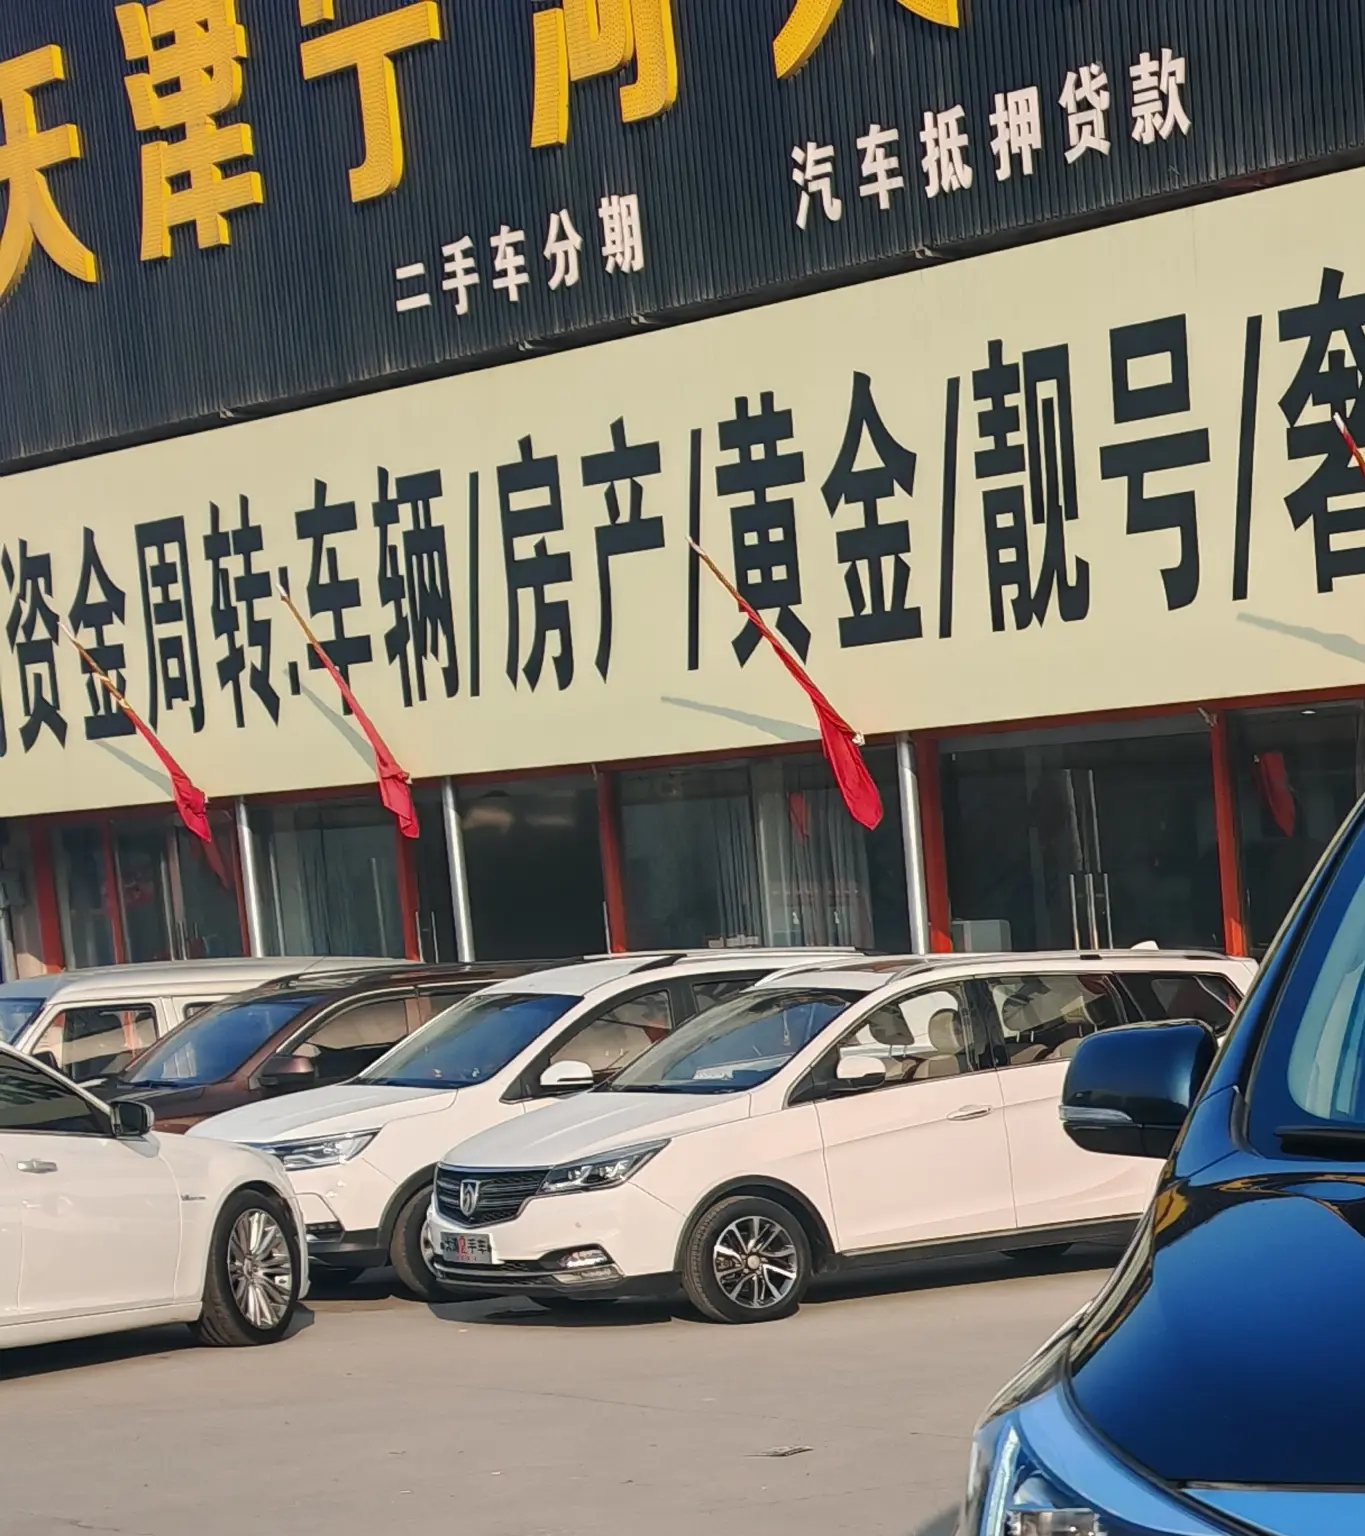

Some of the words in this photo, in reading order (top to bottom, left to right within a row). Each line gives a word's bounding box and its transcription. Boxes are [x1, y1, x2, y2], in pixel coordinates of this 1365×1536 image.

[395, 193, 644, 315] 二手车分期
[791, 47, 1192, 228] 汽车抵押贷款
